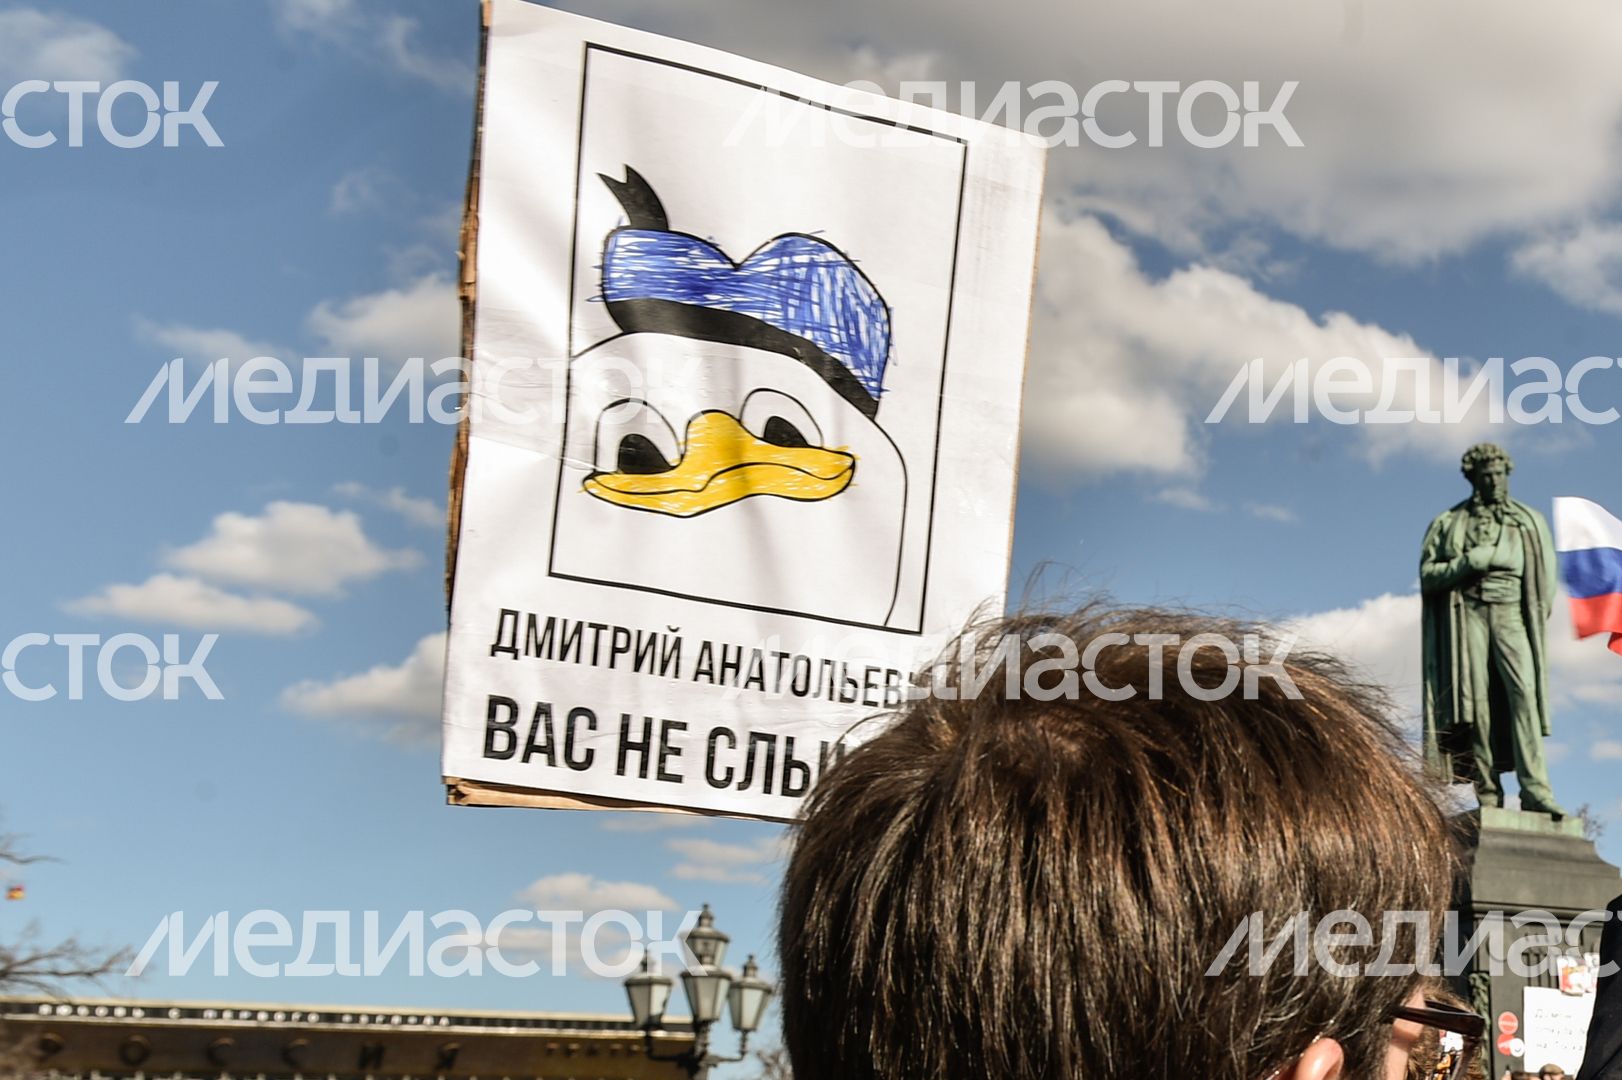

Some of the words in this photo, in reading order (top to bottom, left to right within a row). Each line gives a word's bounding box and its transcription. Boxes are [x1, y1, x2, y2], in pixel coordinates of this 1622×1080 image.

[489, 607, 683, 680] ДМИТРИЙ
[693, 640, 917, 709] АНАТОЛЬЕВ
[482, 694, 599, 772] ВАС
[614, 713, 689, 784] НЕ
[705, 725, 848, 798] СЛЫ
